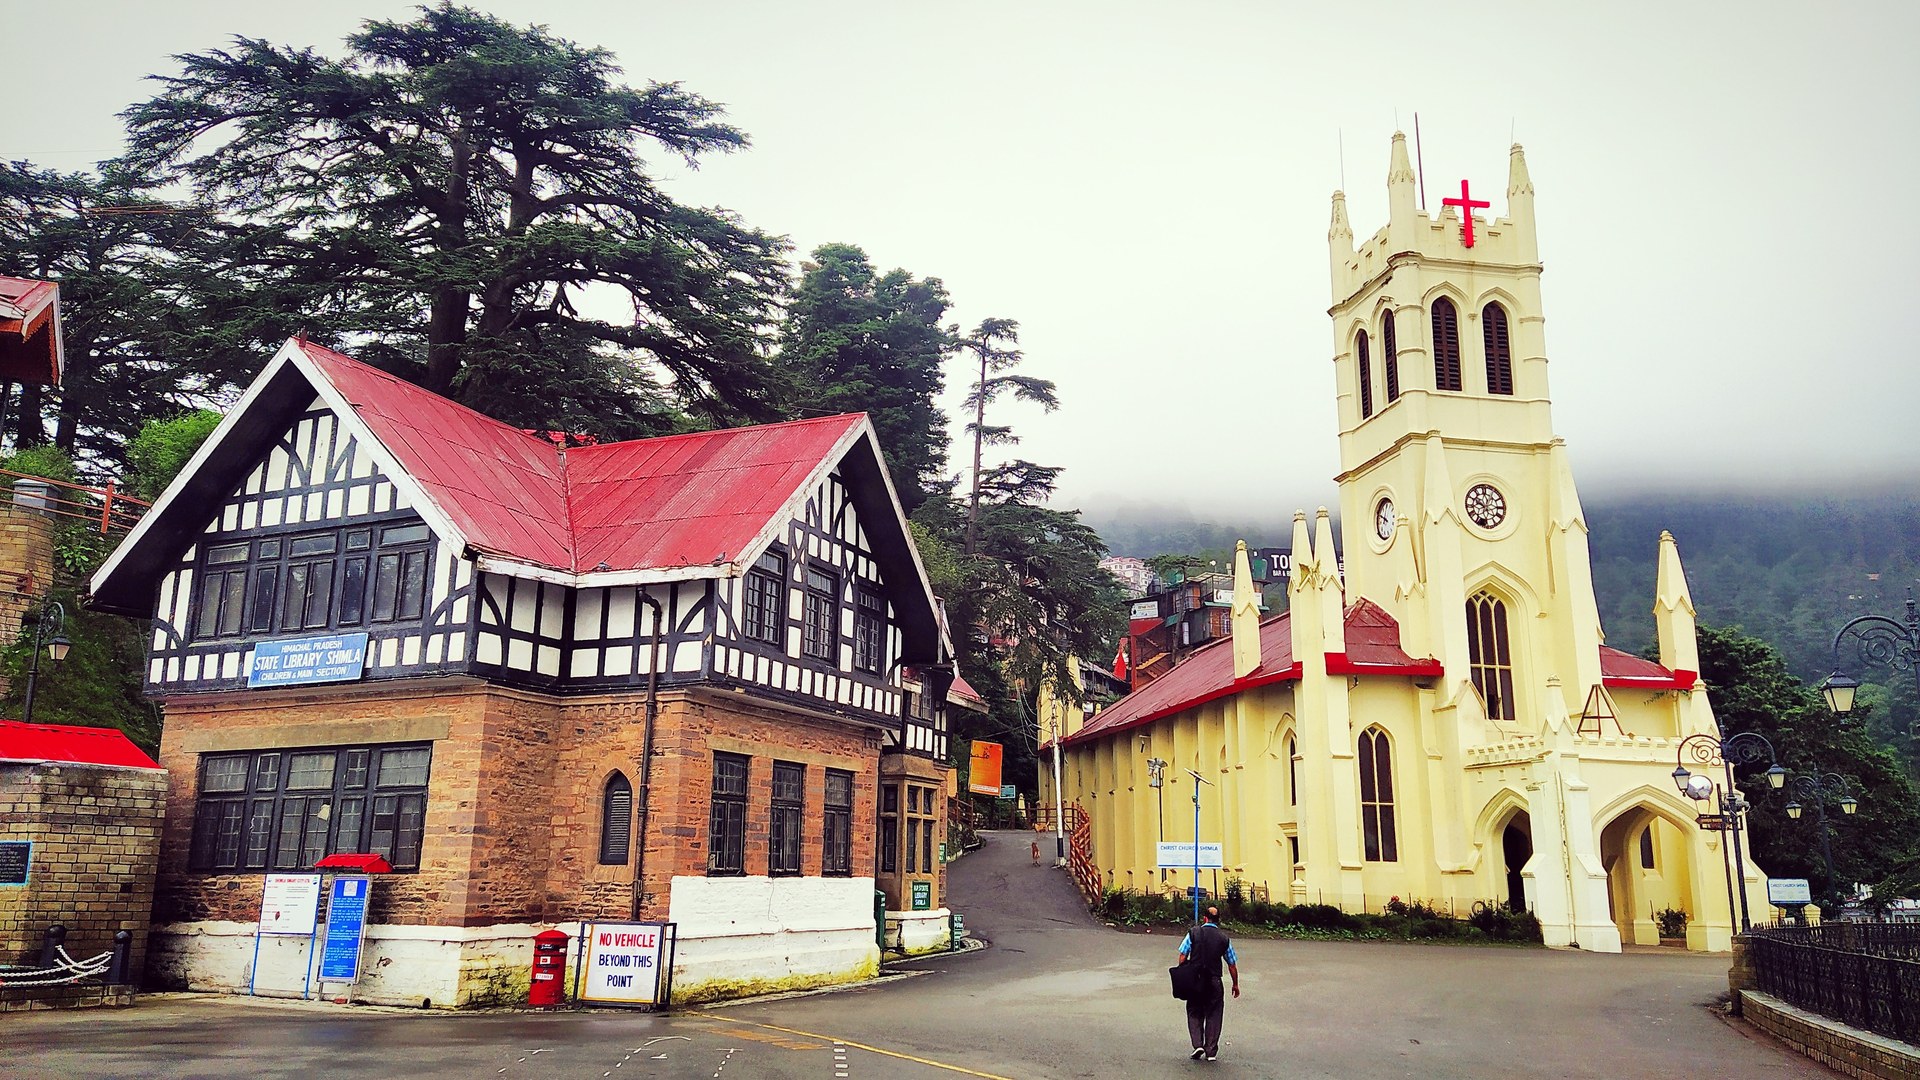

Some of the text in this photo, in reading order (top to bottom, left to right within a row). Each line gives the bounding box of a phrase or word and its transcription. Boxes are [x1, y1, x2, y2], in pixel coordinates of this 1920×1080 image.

[281, 640, 343, 653] HIMACHAL PRADESH
[254, 648, 361, 671] STATE LIBRARY SHIMLA
[297, 669, 313, 678] MAIN
[599, 932, 656, 948] NO VEHICLE
[598, 954, 653, 968] BEYOND THIS
[606, 974, 634, 988] POINT
